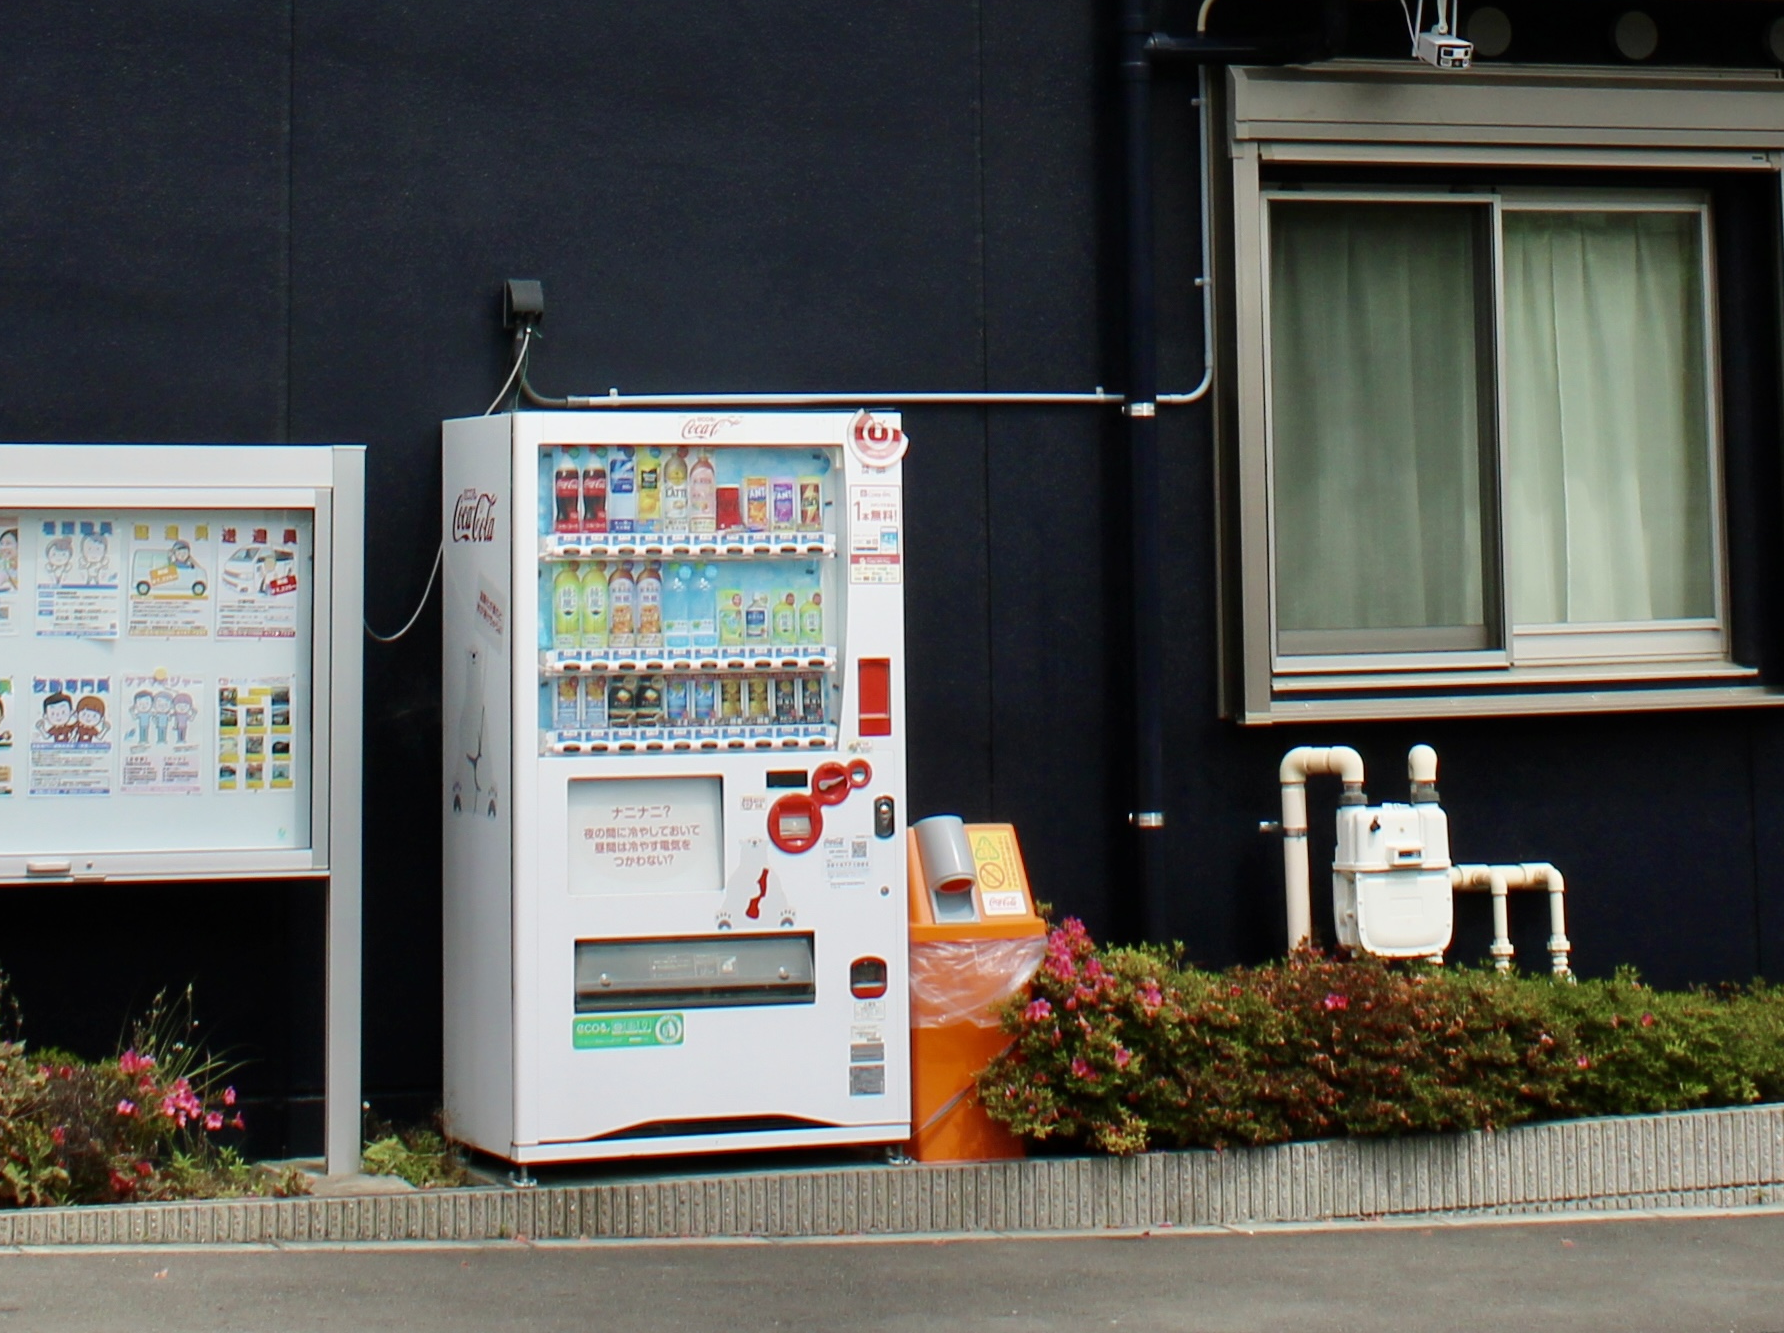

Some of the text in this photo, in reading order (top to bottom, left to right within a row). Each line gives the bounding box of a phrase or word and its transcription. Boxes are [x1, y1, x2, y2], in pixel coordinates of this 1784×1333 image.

[453, 492, 497, 542] Coca-Cola
[612, 805, 671, 820] ナニナニ?
[584, 825, 700, 840] 夜の間に冷やしておいて
[595, 839, 691, 854] 昼間は冷やす電気を
[613, 854, 674, 868] つかわない?
